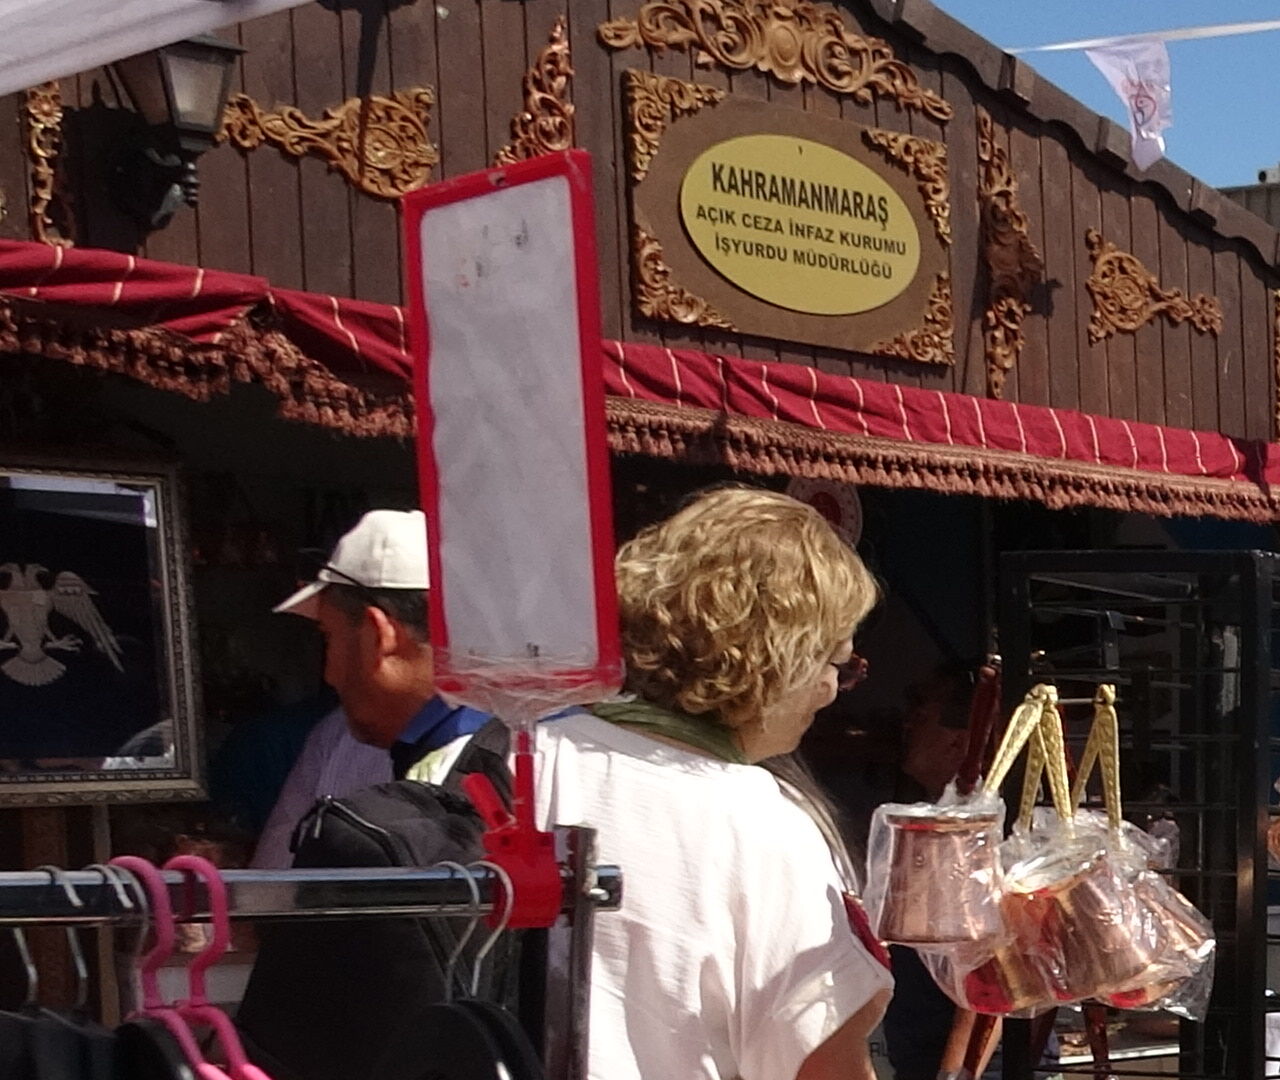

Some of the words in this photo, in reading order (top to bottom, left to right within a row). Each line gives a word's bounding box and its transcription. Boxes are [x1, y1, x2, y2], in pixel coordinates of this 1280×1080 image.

[711, 161, 889, 231] KAHRAMANMARAŞ
[696, 204, 737, 228] AÇIK
[742, 212, 784, 236] CEZA
[789, 218, 835, 243] İNFAZ
[839, 230, 907, 256] KURUMU
[715, 232, 788, 261] İŞYURDU
[793, 249, 892, 279] MÜDÜRLÜĞÜ
